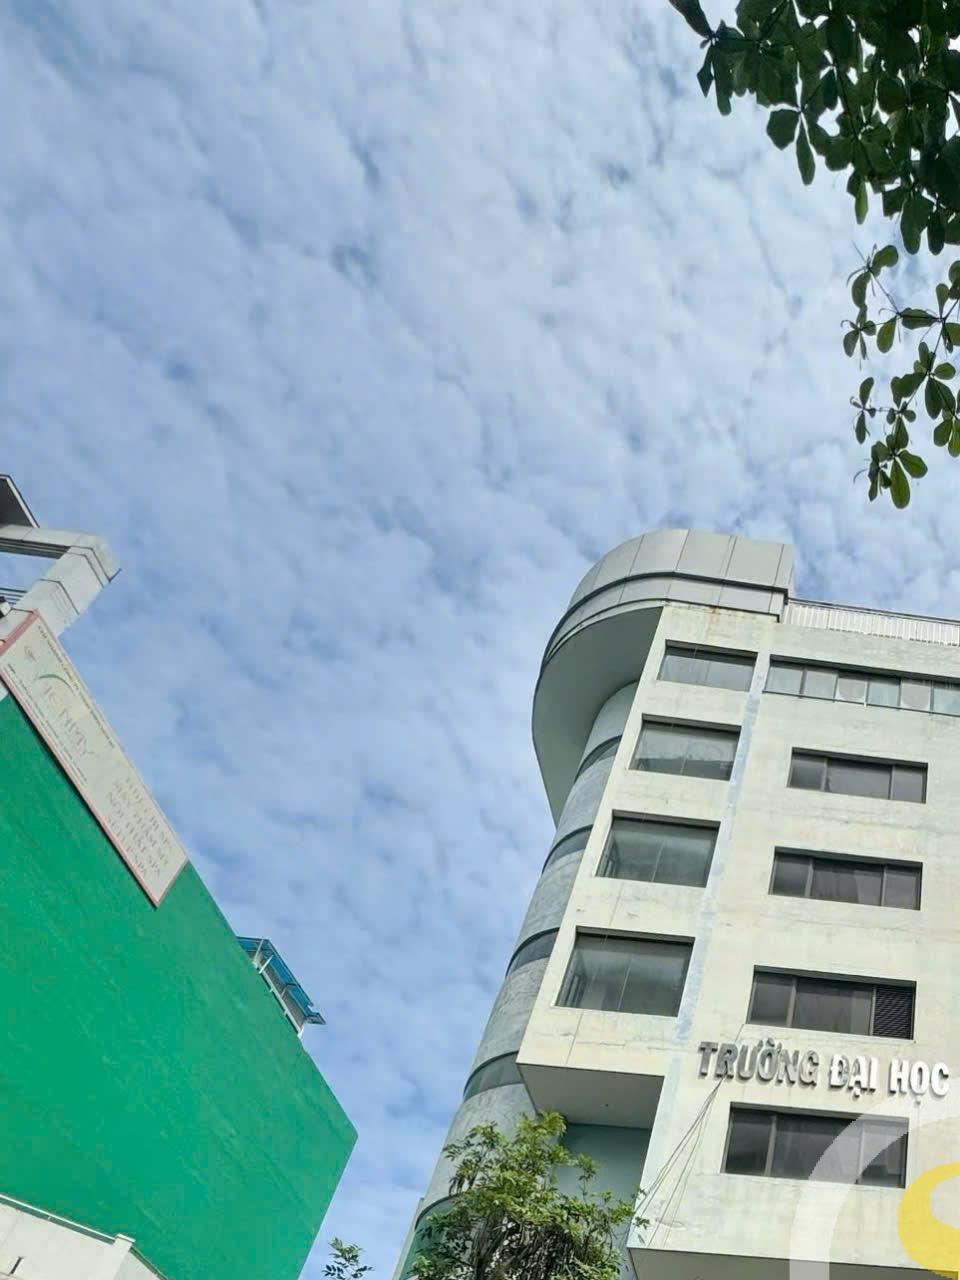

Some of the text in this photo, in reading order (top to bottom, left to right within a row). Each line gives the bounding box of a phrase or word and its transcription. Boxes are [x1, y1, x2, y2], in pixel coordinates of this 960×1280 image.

[698, 1038, 819, 1087] TRƯỜNG
[829, 1054, 876, 1098] ĐẠI
[889, 1059, 949, 1104] HỌC
